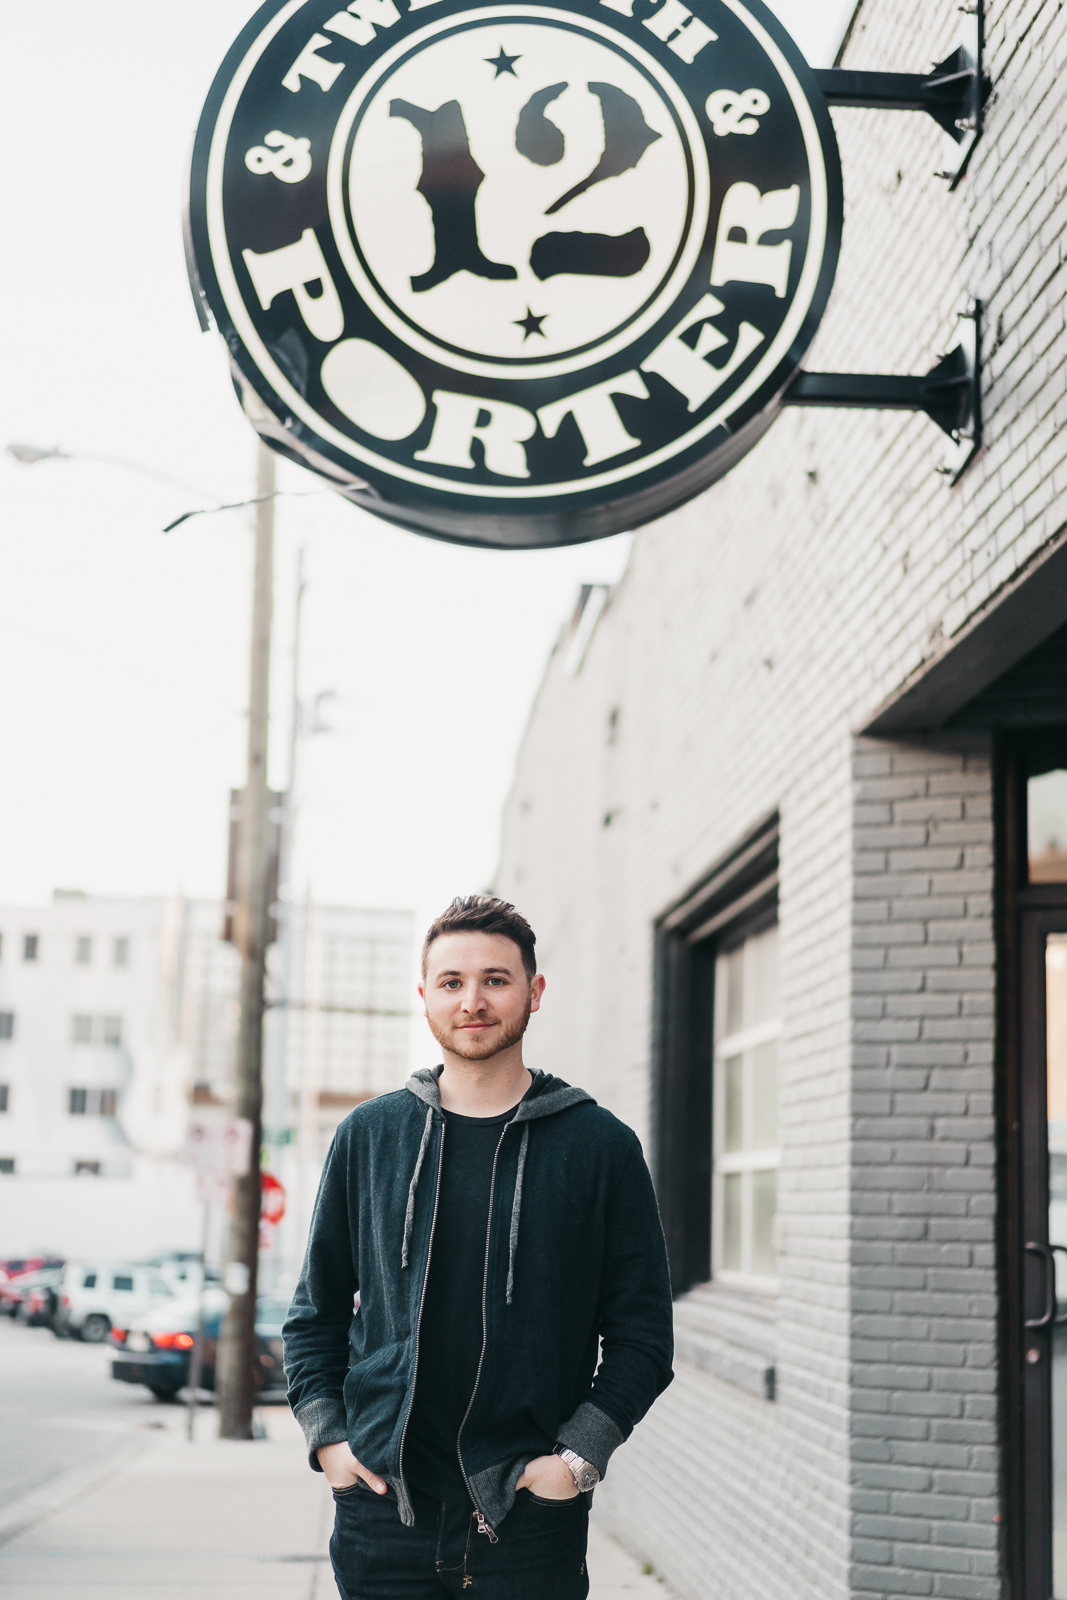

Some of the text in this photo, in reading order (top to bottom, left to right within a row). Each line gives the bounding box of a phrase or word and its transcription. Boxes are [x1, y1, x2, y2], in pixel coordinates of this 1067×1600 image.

[245, 130, 312, 183] &
[705, 89, 770, 136] &
[390, 82, 662, 292] 12
[242, 182, 800, 478] PORTER
